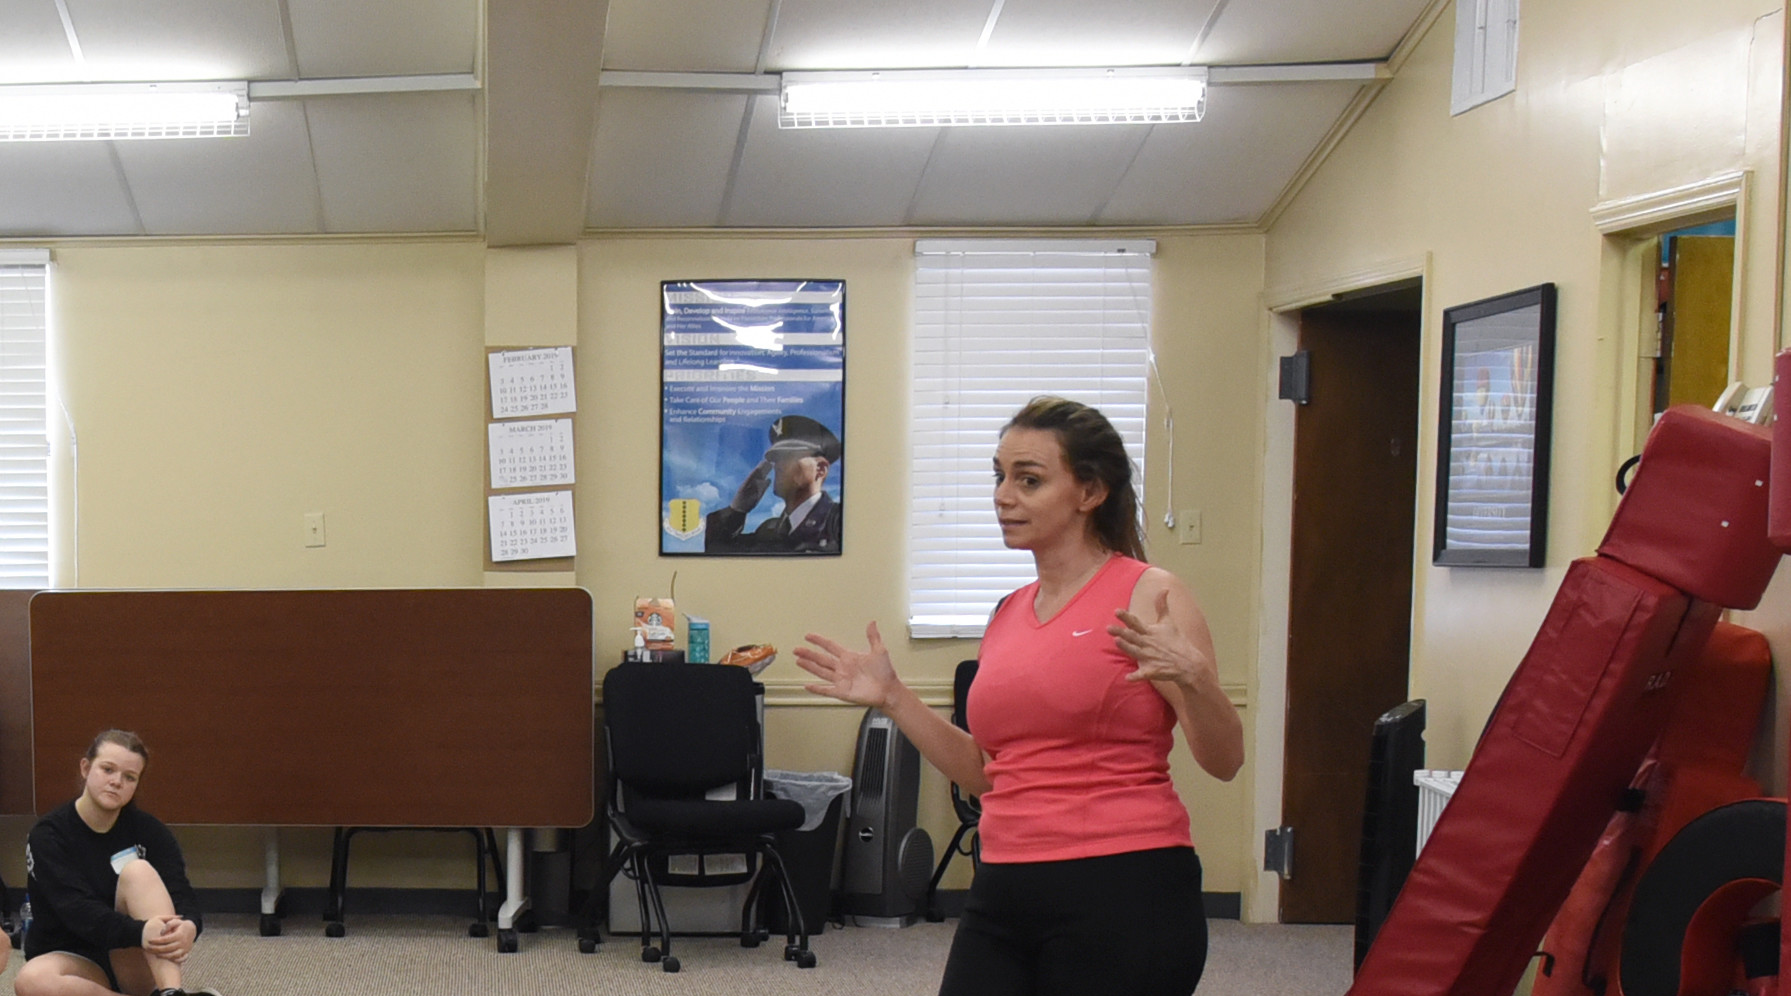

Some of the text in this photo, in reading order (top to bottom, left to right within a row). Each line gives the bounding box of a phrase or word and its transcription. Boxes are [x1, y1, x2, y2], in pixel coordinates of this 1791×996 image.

[502, 354, 542, 364] FEBRUARY
[697, 407, 737, 417] Community
[509, 425, 536, 433] MARCH
